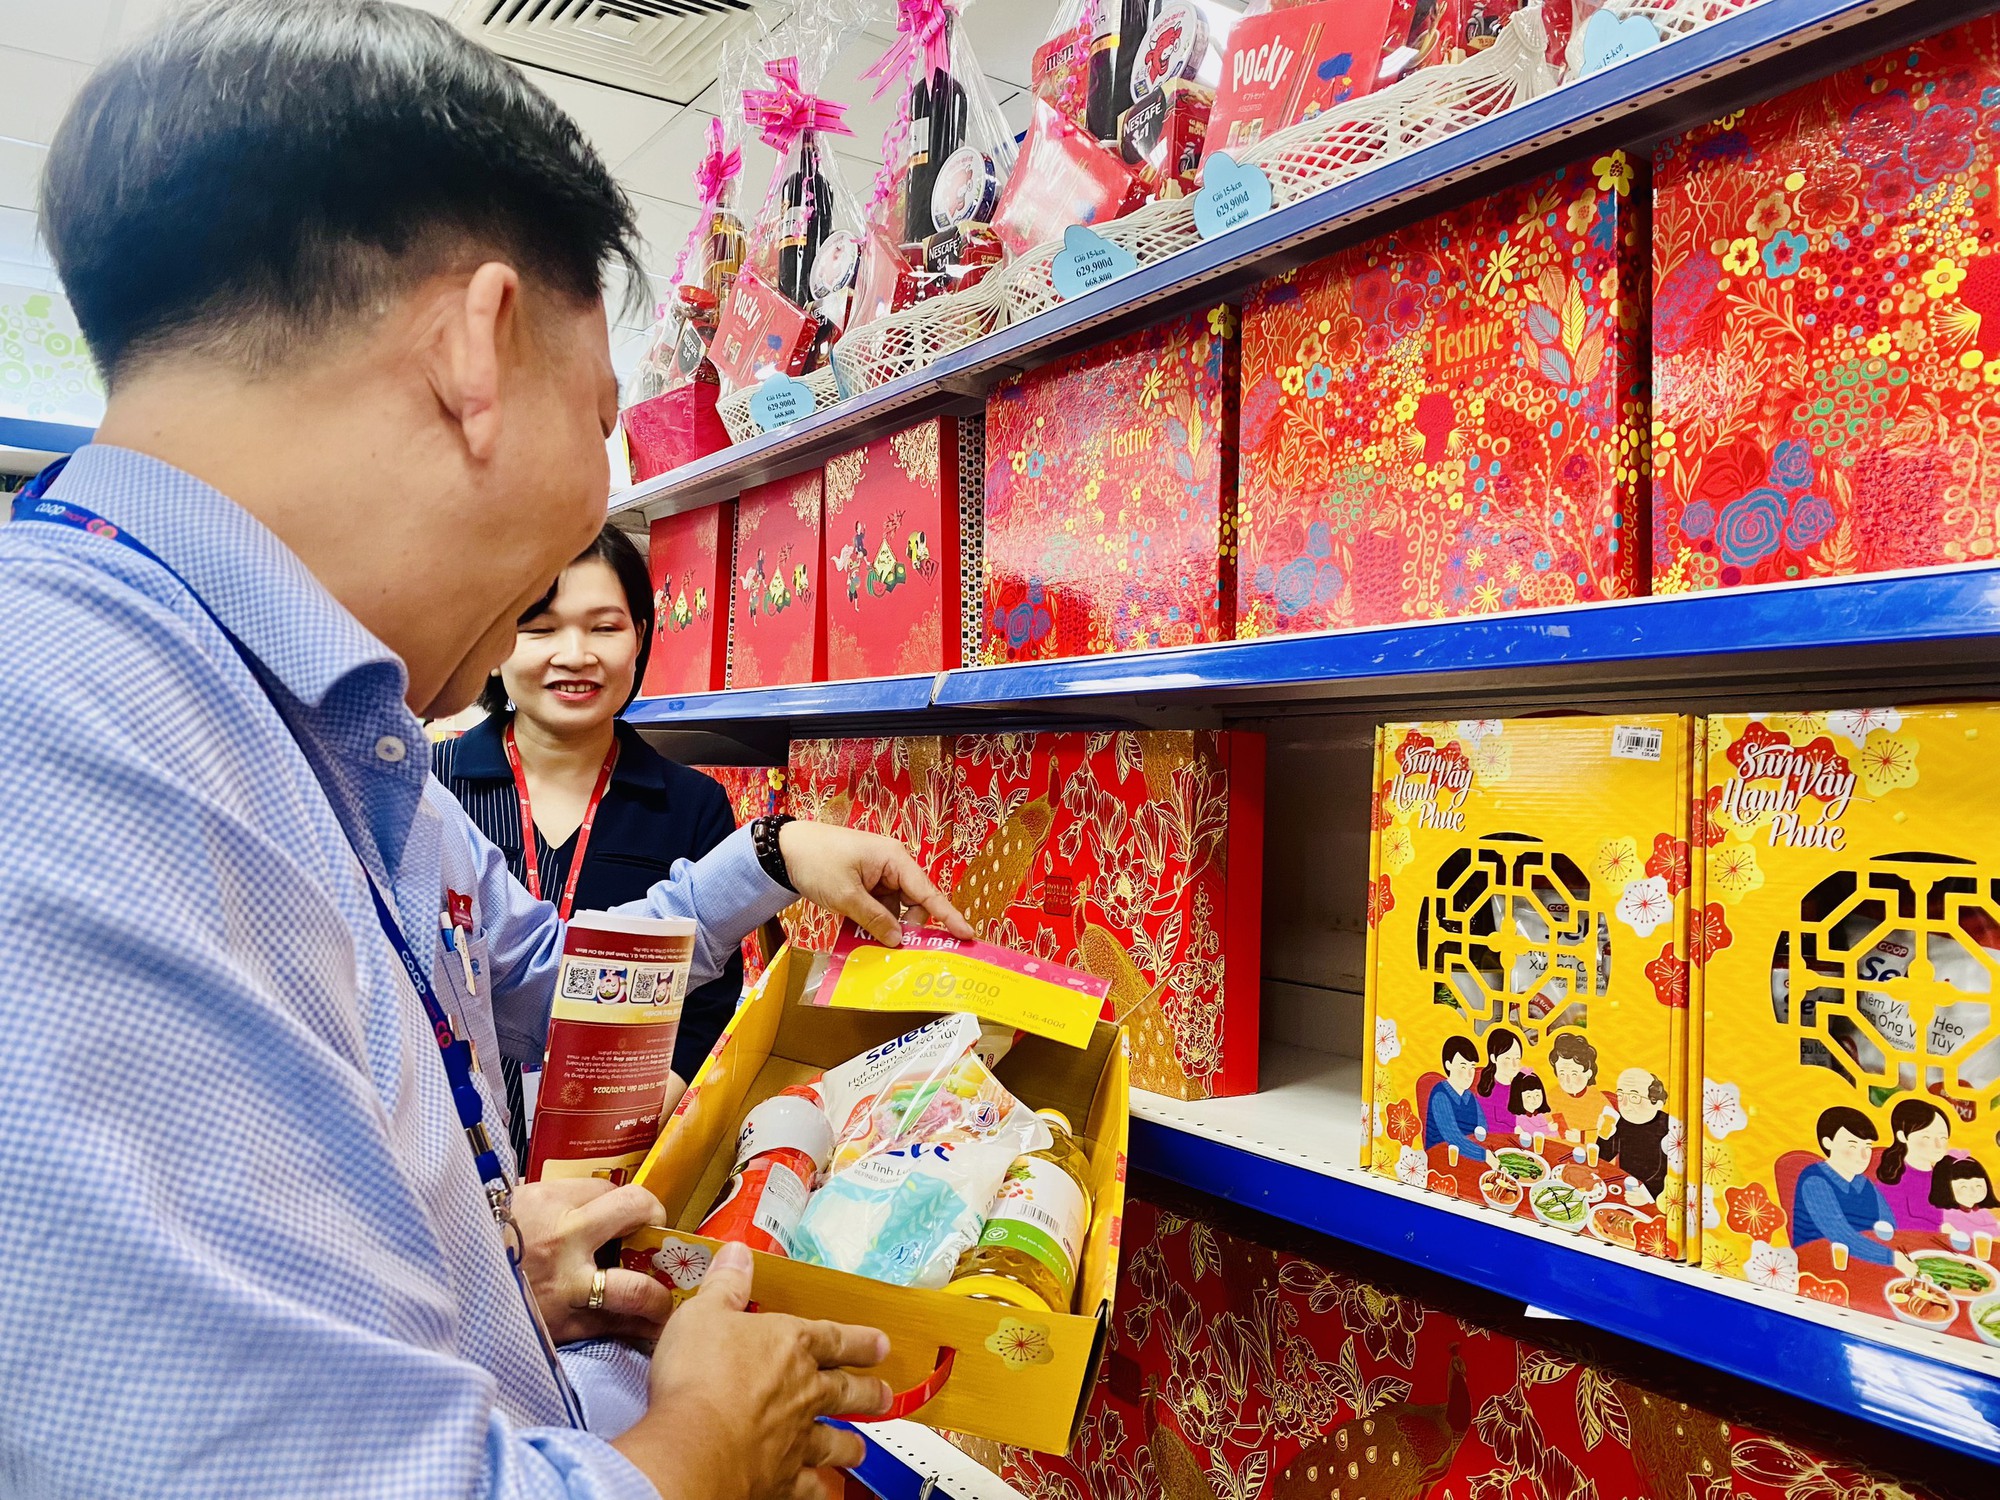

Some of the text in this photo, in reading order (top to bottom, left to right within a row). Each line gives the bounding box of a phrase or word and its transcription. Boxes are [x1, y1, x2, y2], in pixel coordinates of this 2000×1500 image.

[1435, 317, 1504, 367] Festive
[1442, 356, 1497, 380] GIFT SET
[1111, 424, 1153, 460] Festive
[1115, 455, 1149, 471] GIFT SET
[1418, 800, 1467, 832] Phúc
[1768, 812, 1847, 853] Phúc
[1878, 941, 1908, 956] COOP
[1933, 1016, 1966, 1039] Heo,
[1931, 1031, 1956, 1053] Tủy
